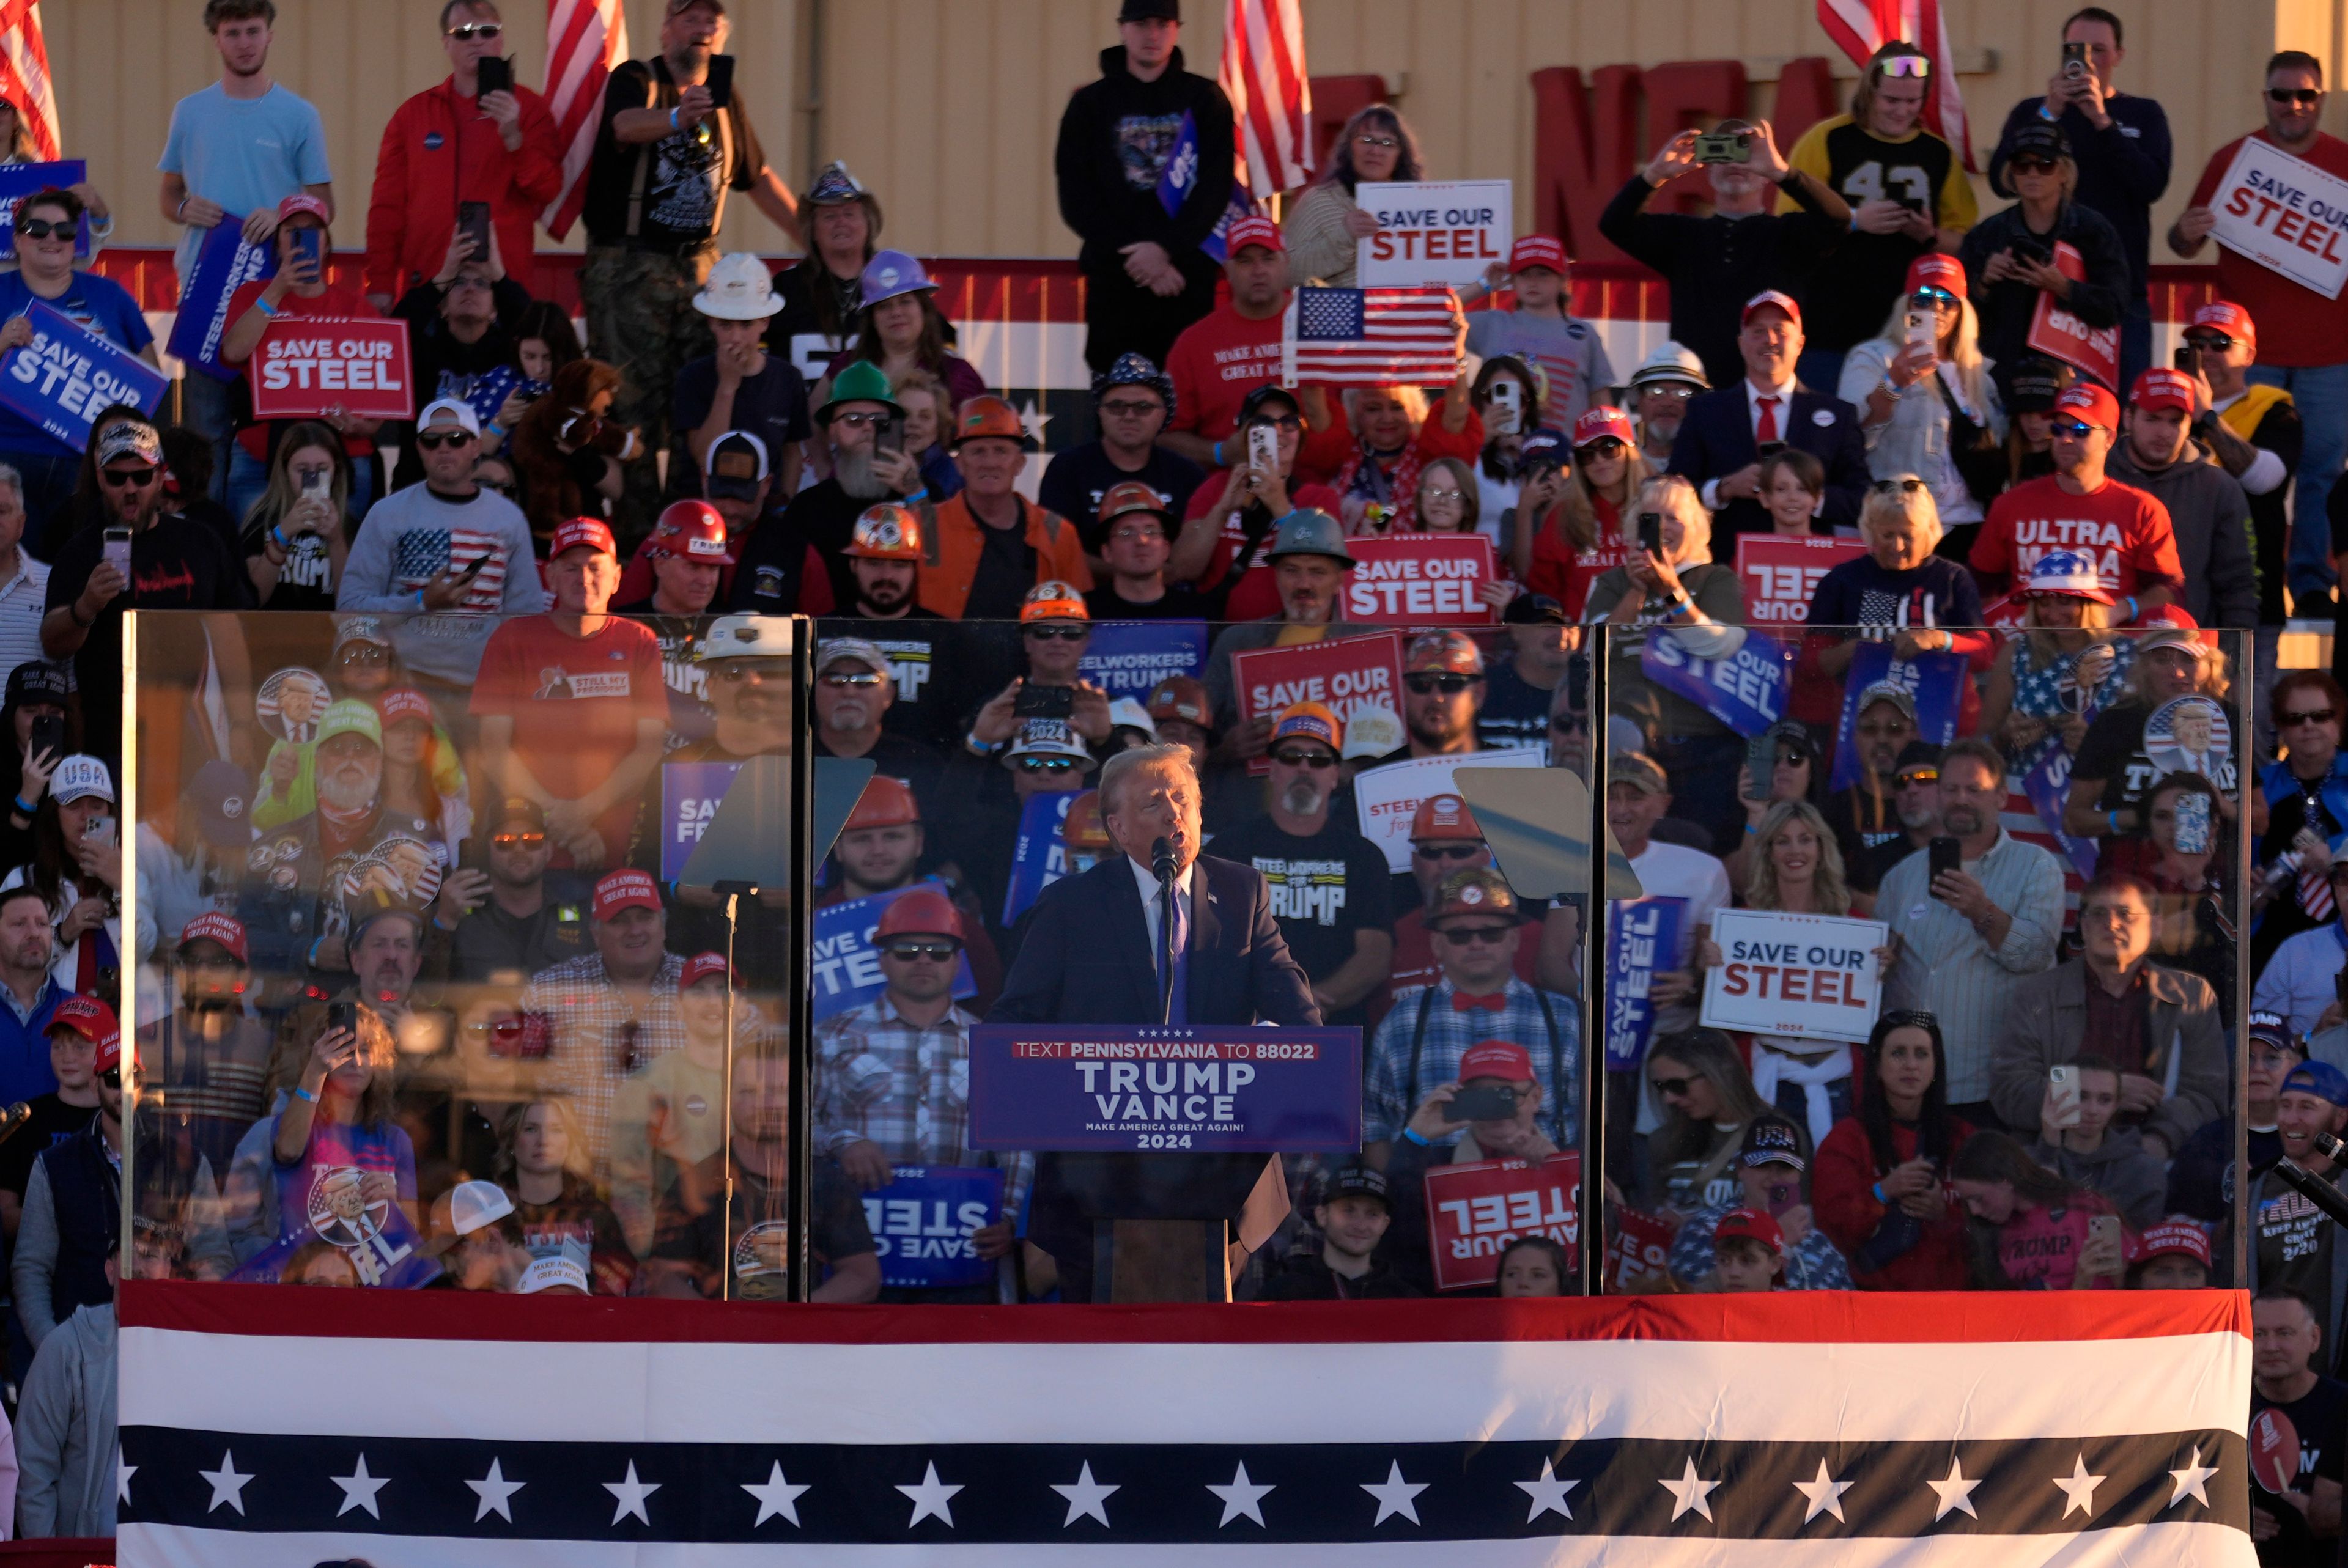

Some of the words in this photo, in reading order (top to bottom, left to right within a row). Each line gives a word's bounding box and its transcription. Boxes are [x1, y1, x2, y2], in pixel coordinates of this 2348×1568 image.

[2246, 170, 2305, 208] SAVE
[1377, 208, 1439, 228] SAVE
[1445, 208, 1494, 226] OUR
[2224, 188, 2342, 267] STEEL
[1371, 228, 1501, 262] STEEL
[266, 339, 333, 360] SAVE
[338, 340, 394, 360] OUR
[31, 331, 94, 380] SAVE
[91, 369, 142, 409] OUR
[262, 358, 402, 391] STEEL
[10, 347, 117, 425] STEE
[2015, 520, 2124, 548] ULTRA
[1352, 559, 1420, 580] SAVE
[1424, 558, 1479, 578] OUR
[1349, 580, 1488, 615] STEEL
[1737, 650, 1781, 685] OUR
[575, 676, 606, 687] STILL
[608, 675, 628, 686] MY
[1252, 677, 1325, 709] SAVE
[1331, 667, 1391, 697] OUR
[1028, 725, 1066, 742] 2024
[64, 764, 104, 787] USA
[597, 879, 618, 895] MAKE
[618, 874, 654, 886] AMERICA
[603, 890, 626, 905] GREAT
[627, 886, 651, 897] AGAIN
[1269, 884, 1346, 919] RUMP
[186, 916, 207, 931] MAKE
[207, 915, 241, 936] AMERICA
[187, 927, 211, 940] GREAT
[210, 927, 235, 943] AGAIN
[1732, 941, 1797, 963] SAVE
[1803, 945, 1864, 970] OUR
[1608, 979, 1627, 1051] SAVE
[1618, 913, 1635, 974] OUR
[1619, 908, 1660, 1058] STEEL
[1722, 962, 1867, 1009] STEEL
[1775, 1023, 1804, 1032] 2024
[1016, 1042, 1065, 1058] TEXT
[1071, 1043, 1219, 1059] PENNSYLVANIA
[1224, 1043, 1250, 1059] TO
[1255, 1043, 1315, 1059] 88022
[1075, 1061, 1256, 1094] TRUMP
[1095, 1095, 1235, 1121] VANCE
[1118, 1123, 1167, 1132] AMERICA
[1207, 1124, 1245, 1132] AGAIN!
[1137, 1134, 1192, 1149] 2024
[2262, 1223, 2293, 1237] KEEP
[534, 1261, 556, 1272] MAKE
[537, 1270, 563, 1281] GREAT
